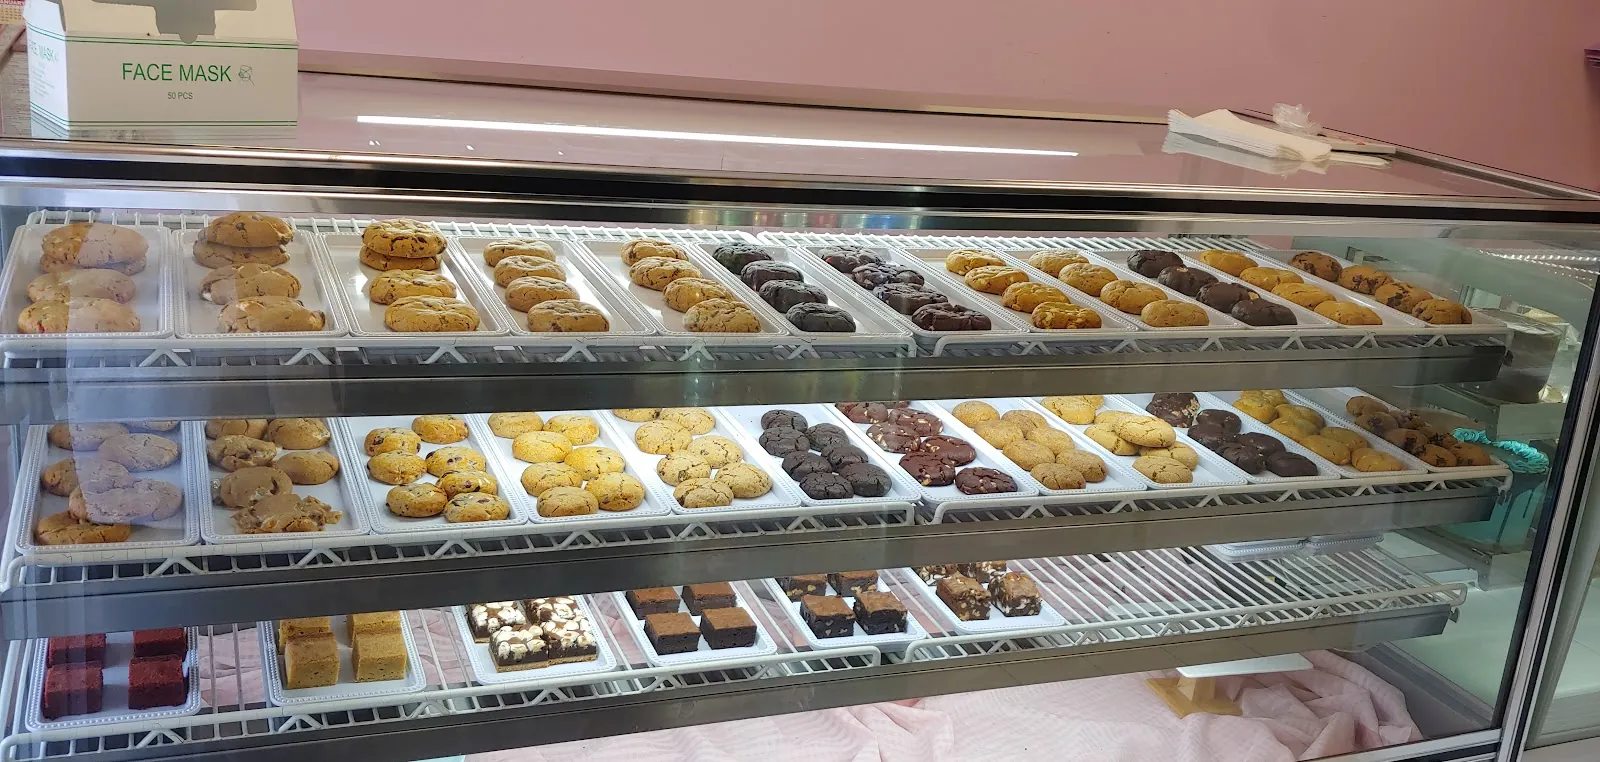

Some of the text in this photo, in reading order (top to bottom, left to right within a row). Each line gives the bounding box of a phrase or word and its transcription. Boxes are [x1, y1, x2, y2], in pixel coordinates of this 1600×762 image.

[122, 63, 232, 82] FACE MASK
[167, 91, 194, 101] 50 PCS
